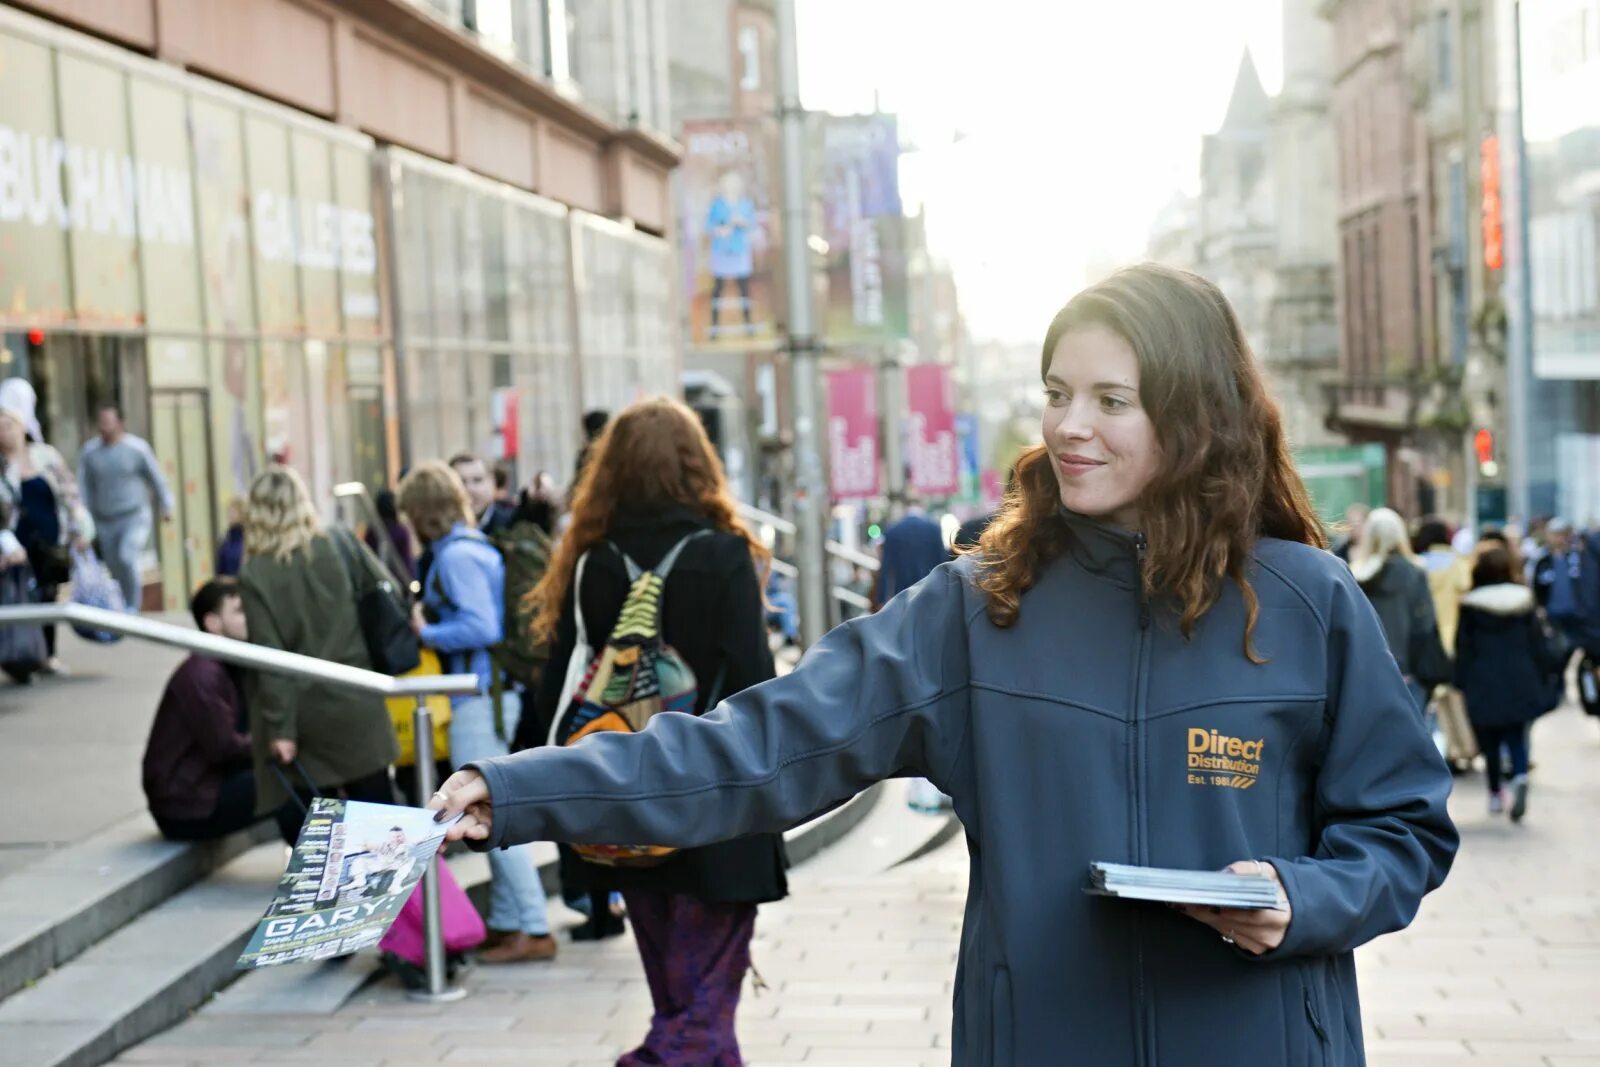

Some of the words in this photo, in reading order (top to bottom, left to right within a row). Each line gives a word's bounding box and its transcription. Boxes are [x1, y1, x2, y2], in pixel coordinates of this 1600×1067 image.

[0, 125, 193, 246] BUCHANAN
[1188, 728, 1264, 760] Direct
[1188, 754, 1259, 774] Distribution
[1188, 774, 1207, 785] Est.
